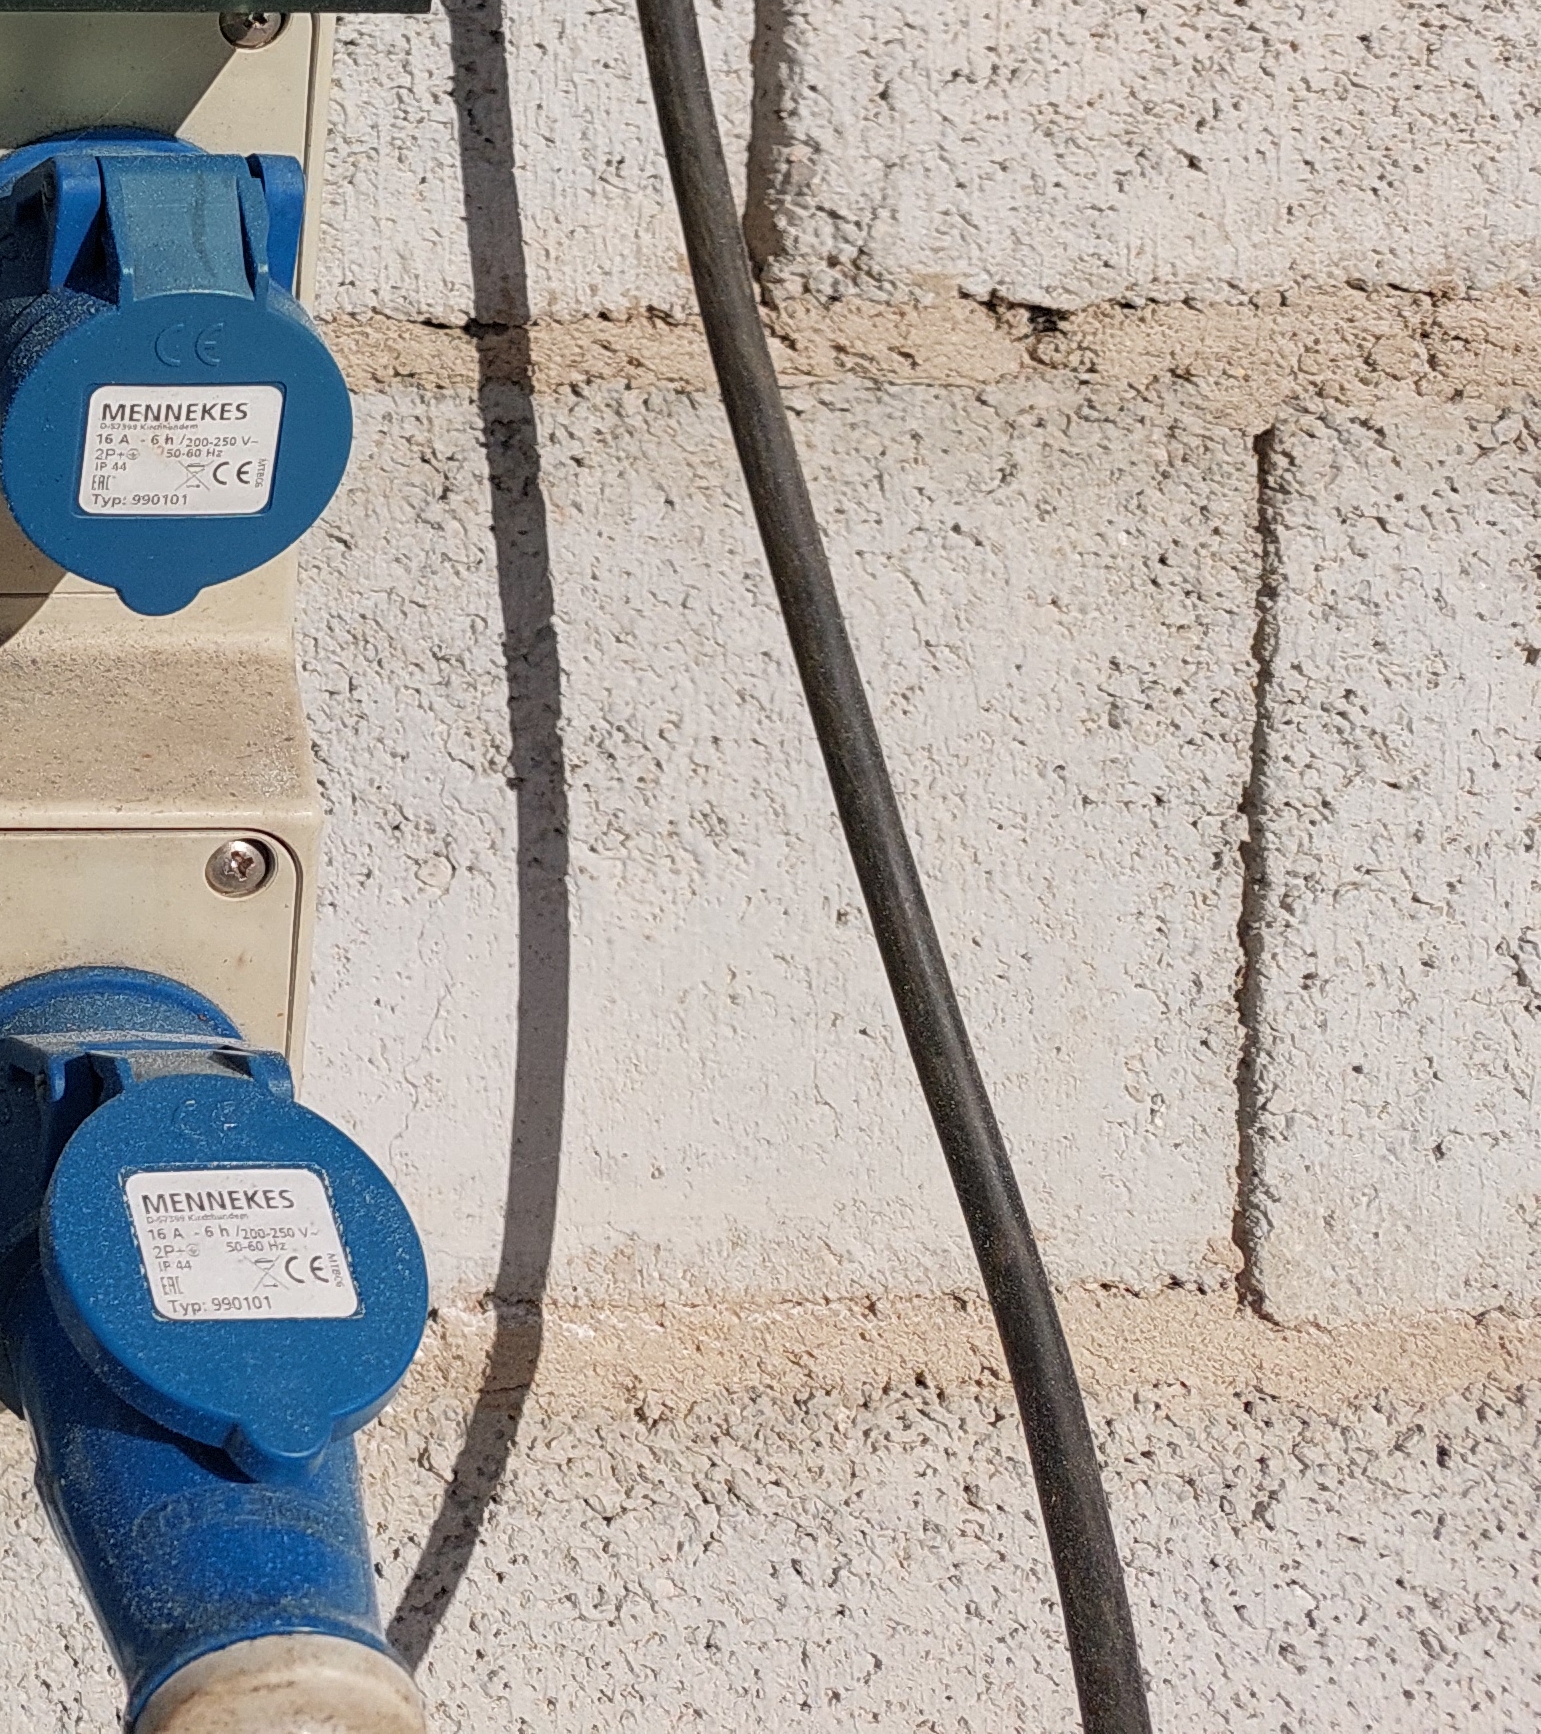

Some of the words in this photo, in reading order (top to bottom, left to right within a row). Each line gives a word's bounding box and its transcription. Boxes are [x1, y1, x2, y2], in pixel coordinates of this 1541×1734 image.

[101, 403, 249, 422] MENNEKES
[96, 434, 113, 444] 16
[119, 434, 129, 444] A
[151, 435, 159, 444] 6
[165, 434, 174, 444] h
[167, 449, 201, 458] 50-60
[206, 449, 223, 457] Hz
[95, 463, 107, 471] IP
[112, 462, 126, 471] 44
[213, 461, 252, 485] CE
[92, 494, 127, 507] Typ:
[132, 494, 187, 505] 990101
[142, 1189, 295, 1214] MENNEKES
[148, 1228, 166, 1239] 16
[173, 1227, 184, 1239] A
[205, 1226, 214, 1237] 6
[219, 1226, 229, 1237] h
[227, 1242, 264, 1252] 50-60
[269, 1241, 287, 1251] Hz
[159, 1261, 171, 1271] IP
[176, 1261, 192, 1270] 44
[285, 1256, 330, 1284] CE
[168, 1301, 206, 1316] Typ:
[212, 1296, 271, 1311] 990101
